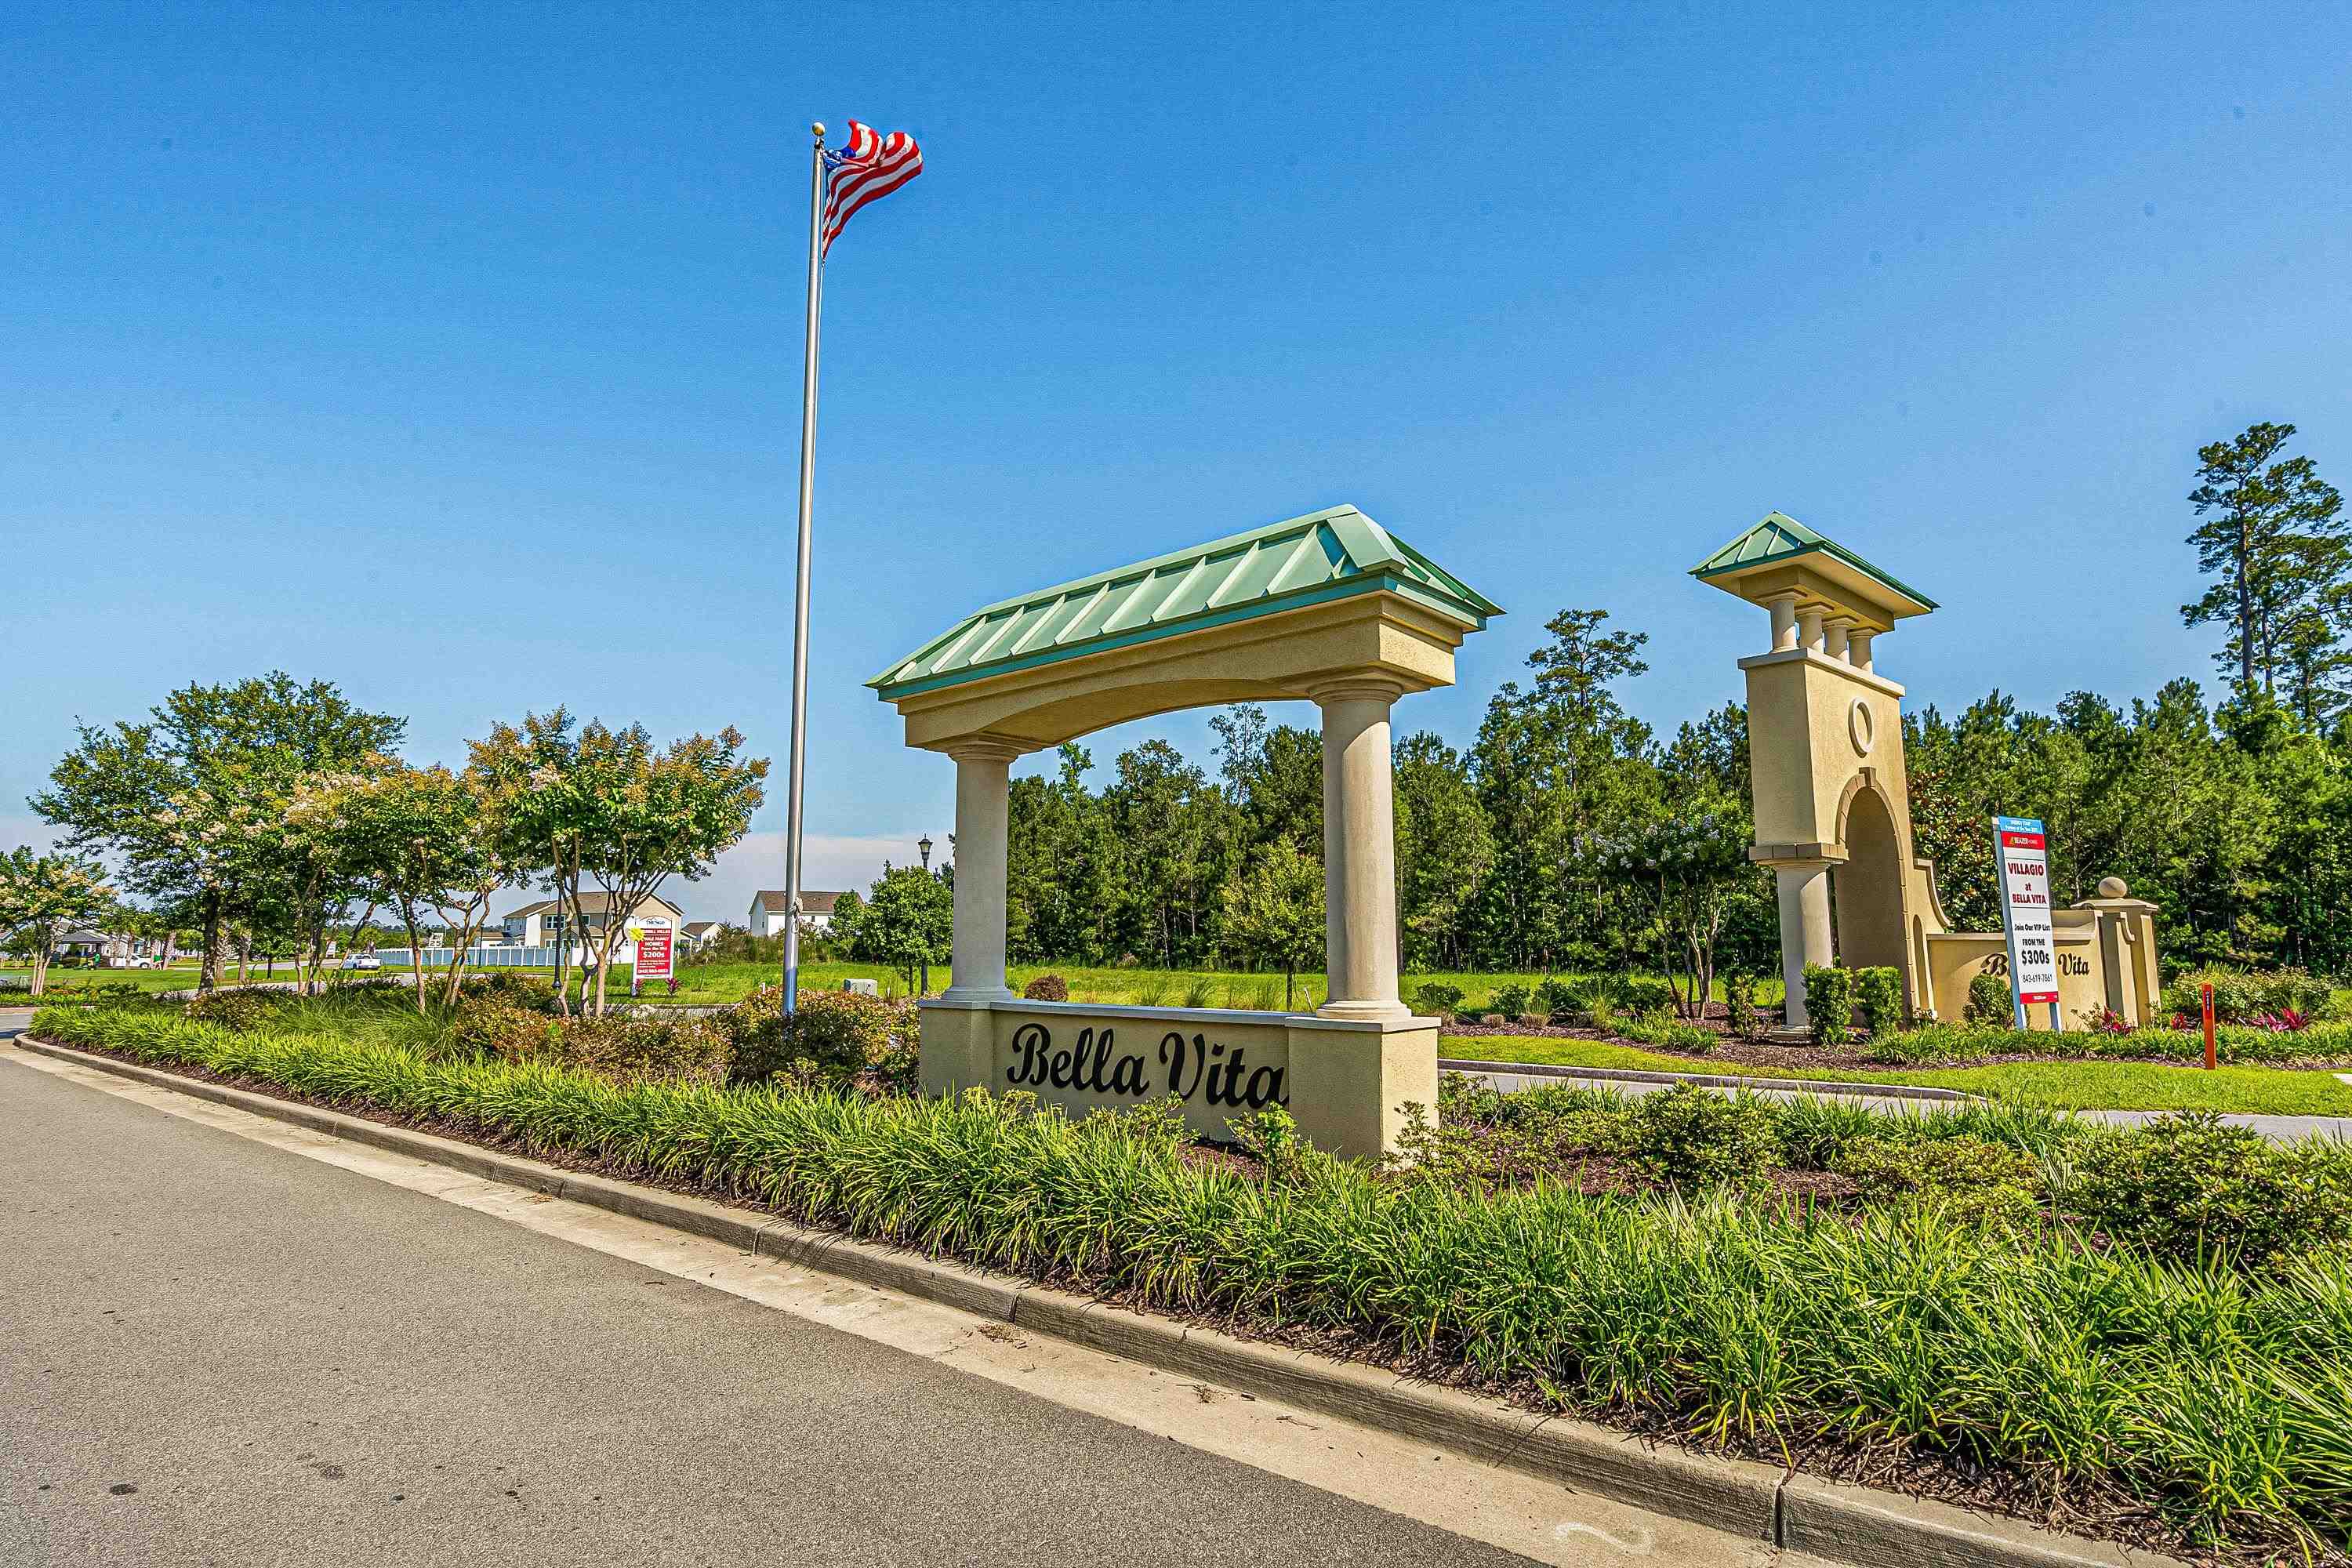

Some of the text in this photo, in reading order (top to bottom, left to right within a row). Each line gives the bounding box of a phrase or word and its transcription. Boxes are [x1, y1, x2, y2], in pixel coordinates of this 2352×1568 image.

[2007, 862, 2044, 876] VILLAGIO
[2024, 882, 2031, 891] at
[2012, 894, 2047, 904] BELLA VITA
[2022, 949, 2049, 965] $300s
[2058, 953, 2089, 975] Vita
[1007, 1023, 1290, 1109] Bella Vita
